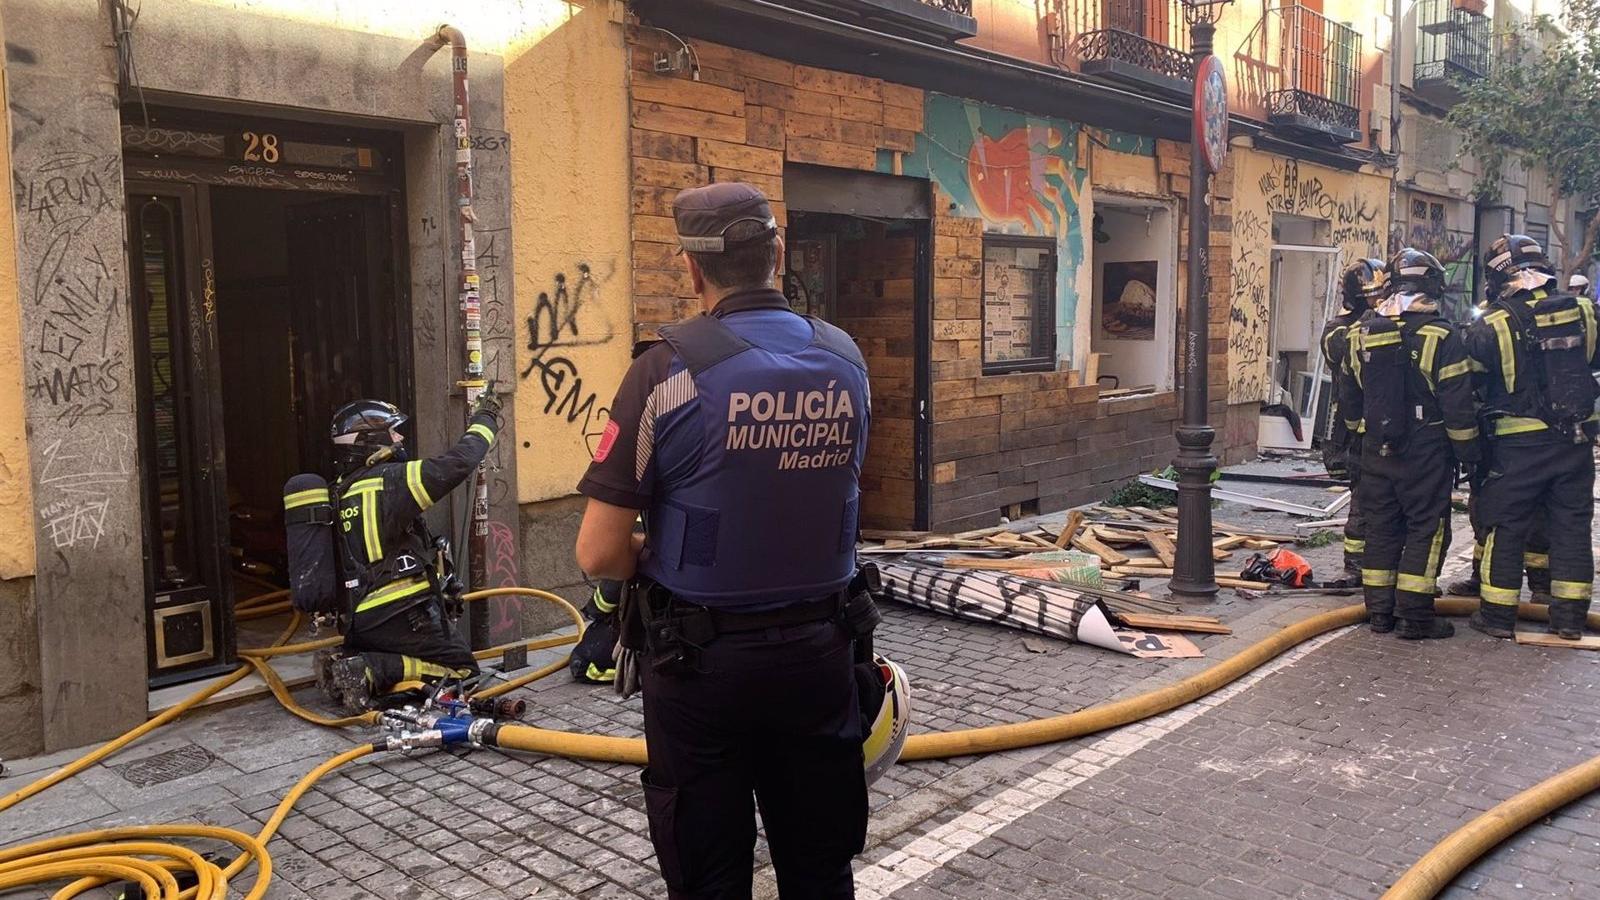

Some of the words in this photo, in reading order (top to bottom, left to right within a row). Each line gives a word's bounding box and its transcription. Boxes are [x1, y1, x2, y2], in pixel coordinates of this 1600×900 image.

[242, 131, 279, 163] 28
[728, 379, 854, 423] POLICÍA
[726, 421, 853, 451] MUNICIPAL
[778, 449, 852, 471] Madrid
